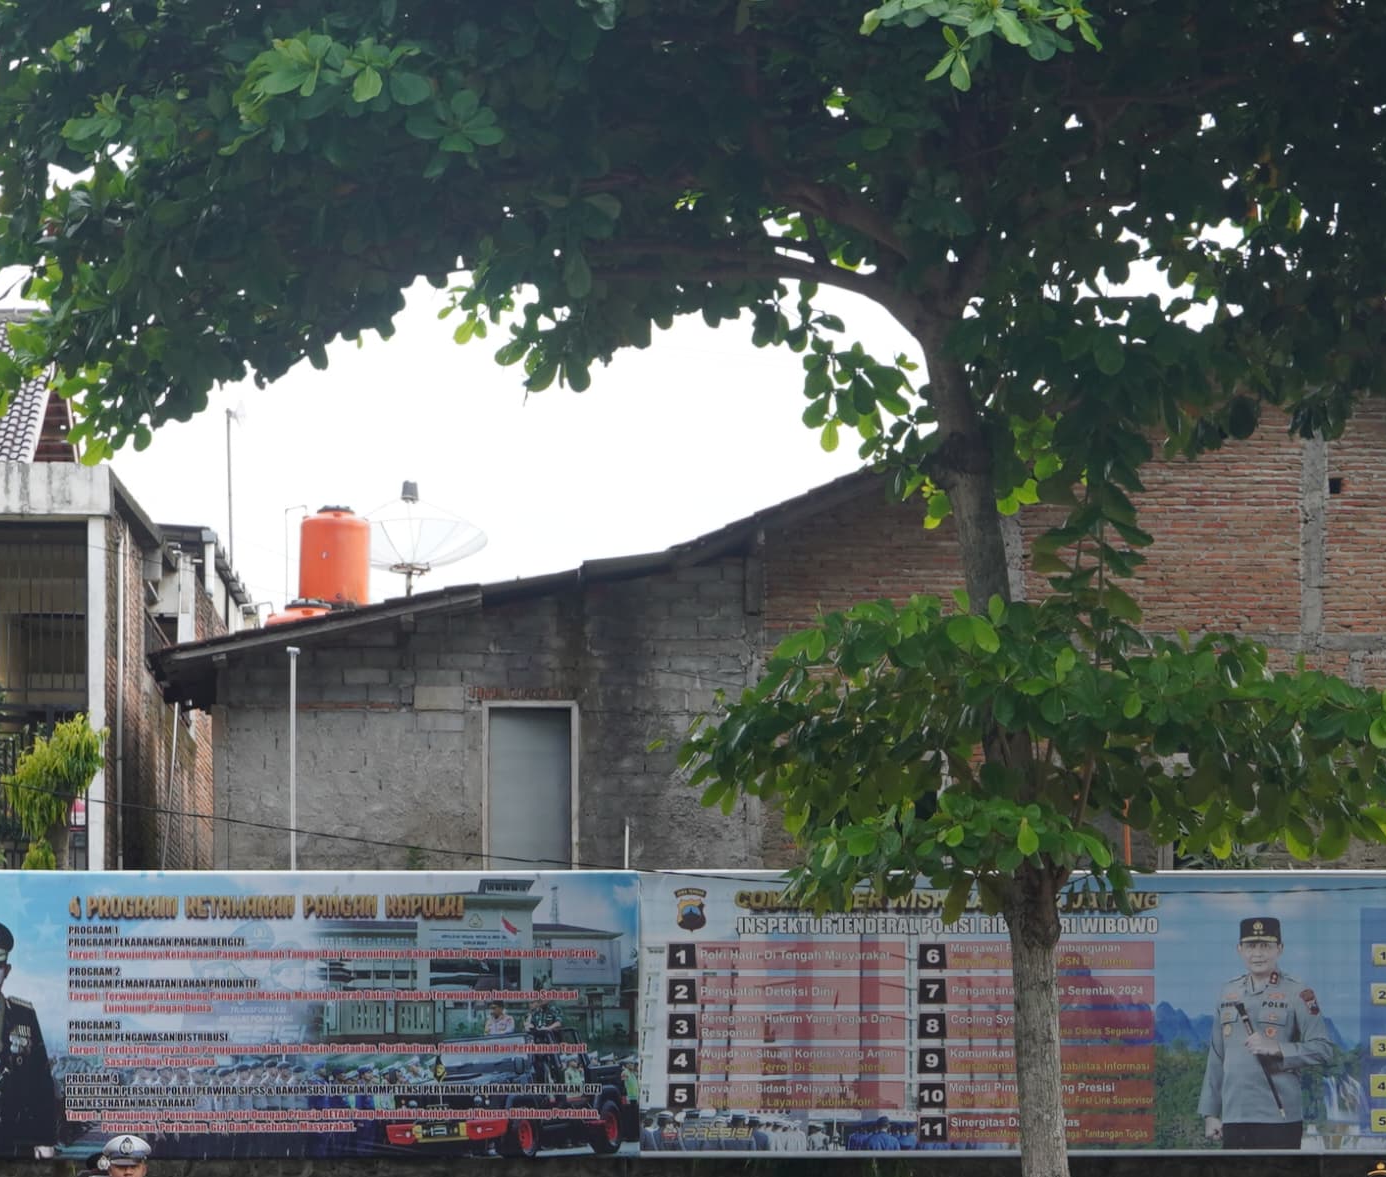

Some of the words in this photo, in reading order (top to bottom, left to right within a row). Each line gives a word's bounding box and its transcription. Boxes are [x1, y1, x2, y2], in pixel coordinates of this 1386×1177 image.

[87, 895, 178, 919] PROGRAM
[185, 895, 296, 919] KETAHANAN
[304, 895, 377, 919] PANGAN
[385, 895, 464, 919] KAPOLRI
[68, 926, 112, 934] PROGRAM
[737, 917, 832, 934] INSPEKTUR
[835, 917, 919, 934] JENDERAL
[1081, 917, 1158, 934] WIBOWO
[68, 938, 112, 946] PROGRAM
[114, 938, 172, 946] PEKARANGAN
[174, 938, 209, 946] PANGAN
[211, 938, 245, 946] BERGIZI
[675, 951, 686, 964] 1
[700, 950, 728, 960] Polri
[730, 950, 761, 960] Hadir
[764, 950, 777, 960] Di
[780, 950, 821, 962] Tengah
[825, 950, 890, 962] Masyarakat
[69, 968, 112, 976] PROGRAM
[69, 980, 112, 988] PROGRAM
[115, 980, 176, 988] PEMANFAATAN
[178, 980, 207, 988] LAHAN
[209, 980, 258, 988] PRODUKTIF
[674, 985, 688, 999] 2
[700, 987, 762, 999] Penguatan
[764, 987, 808, 997] Deteksi
[926, 985, 939, 999] 7
[1067, 986, 1115, 996] Serentak
[1119, 986, 1144, 996] 2024
[69, 1021, 112, 1029] PROGRAM
[675, 1020, 688, 1034] 3
[764, 1014, 803, 1024] Hukum
[805, 1014, 832, 1026] Yang
[836, 1014, 868, 1026] Tegas
[871, 1014, 892, 1024] Dan
[926, 1019, 939, 1033] 8
[950, 1015, 993, 1026] Cooling
[69, 1033, 112, 1041] PROGRAM
[115, 1033, 175, 1041] PENGAWASAN
[177, 1033, 228, 1041] DISTRIBUSI
[925, 1053, 939, 1067] 9
[66, 1074, 111, 1083] PROGRAM
[920, 1090, 944, 1102] 10
[949, 1083, 991, 1094] Menjadi
[1078, 1083, 1115, 1092] Presisi
[1378, 1082, 1386, 1091] 4
[674, 1089, 687, 1102] 5
[66, 1099, 85, 1107] DAN
[87, 1099, 136, 1107] KESEHATAN
[138, 1099, 195, 1107] MASYARAKAT
[921, 1123, 943, 1136] 11
[950, 1118, 1005, 1129] Sinergitas
